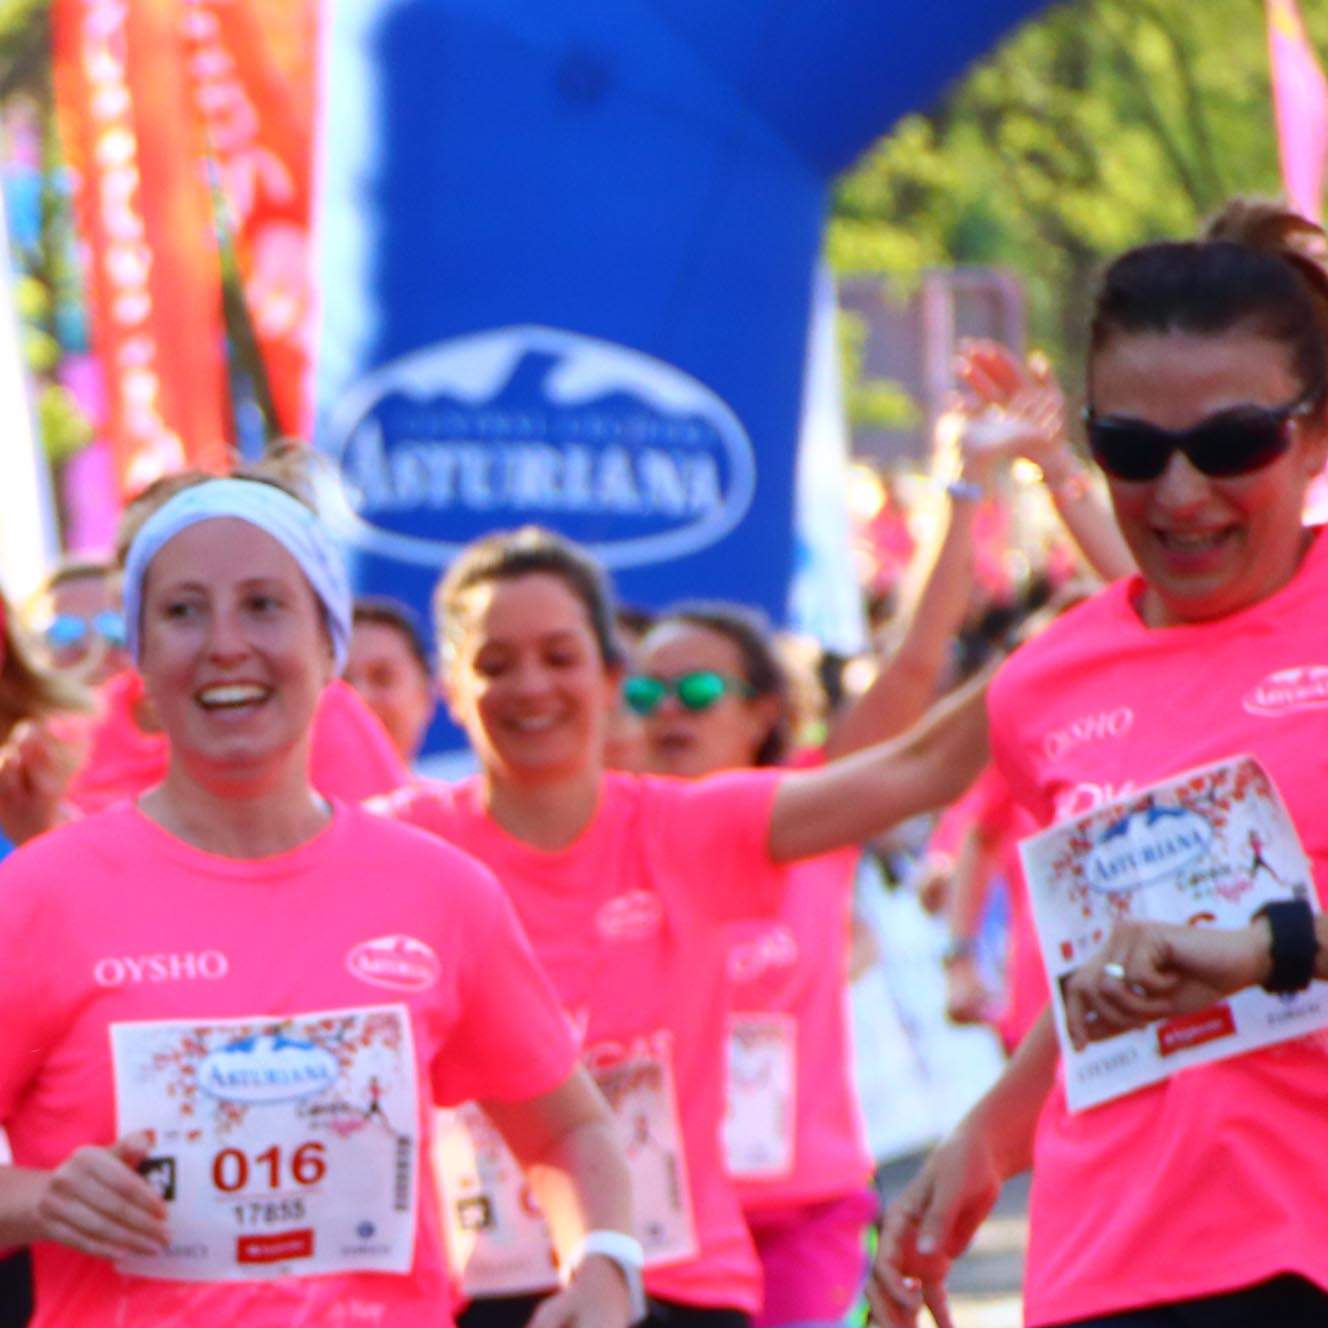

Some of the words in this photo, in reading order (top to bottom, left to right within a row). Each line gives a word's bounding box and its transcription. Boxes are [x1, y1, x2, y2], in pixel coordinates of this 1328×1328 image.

[352, 412, 724, 515] ASTURIANA
[93, 948, 230, 988] OYSHO
[210, 1141, 328, 1194] 016
